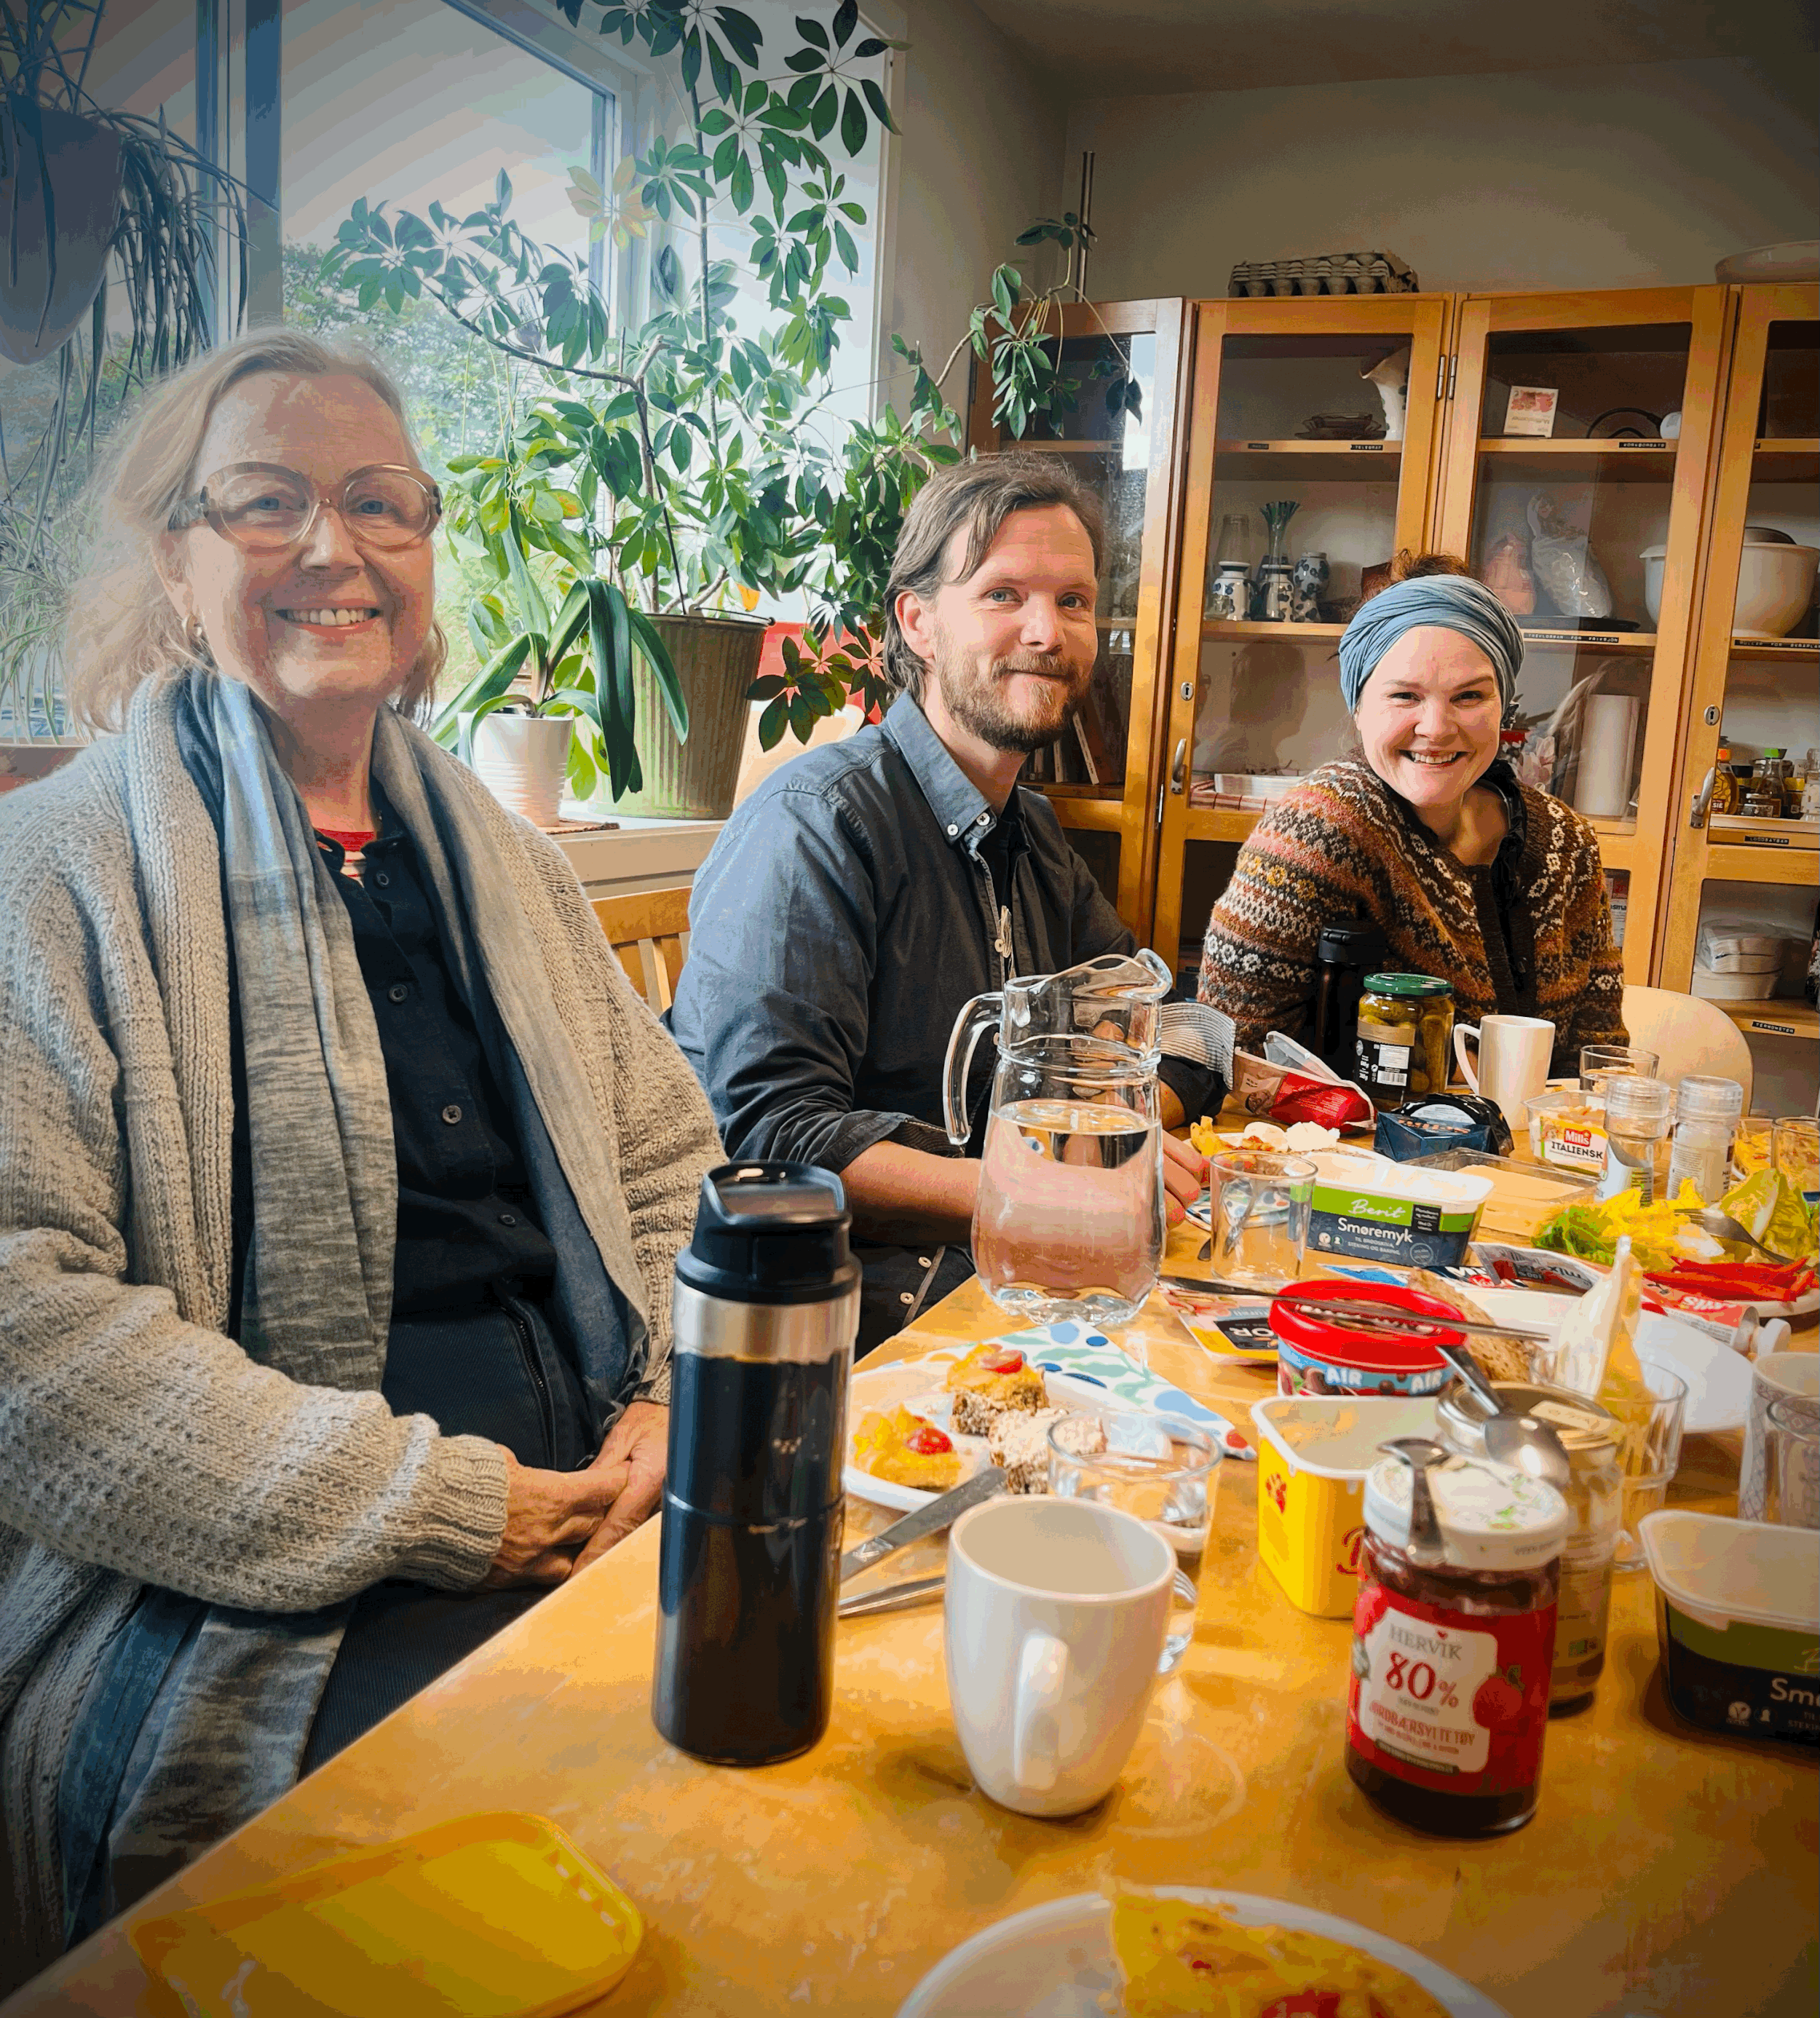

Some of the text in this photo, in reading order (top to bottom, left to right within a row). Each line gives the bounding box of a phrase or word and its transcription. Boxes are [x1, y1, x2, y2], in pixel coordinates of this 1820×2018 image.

[1565, 1130, 1590, 1146] Mills
[1551, 1141, 1603, 1160] ITALIENSK
[1348, 1198, 1406, 1218] Berit
[1337, 1216, 1413, 1246] Smøremyk
[1325, 1366, 1363, 1387] AIR
[1411, 1370, 1443, 1394] AIR
[1390, 1623, 1463, 1661] HERVIK
[1386, 1651, 1459, 1709] 80%
[1770, 1677, 1819, 1707] Sm
